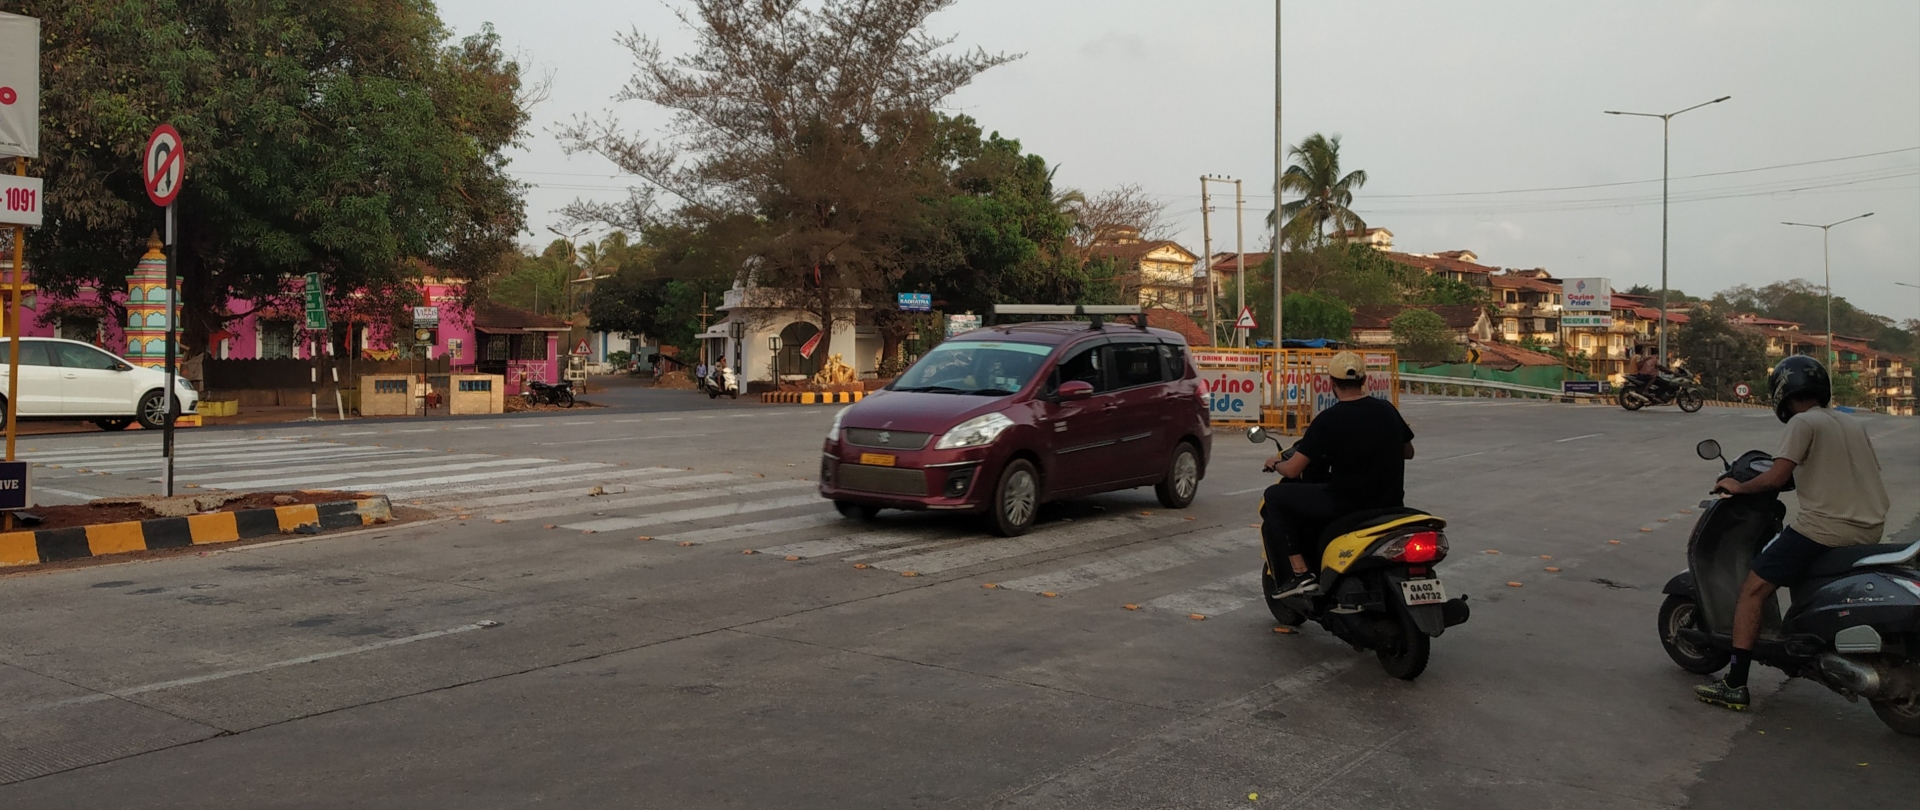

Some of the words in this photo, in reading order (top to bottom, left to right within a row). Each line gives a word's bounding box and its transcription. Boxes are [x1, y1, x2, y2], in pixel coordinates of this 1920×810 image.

[5, 187, 35, 212] 1091
[1210, 393, 1244, 412] ide
[1410, 584, 1422, 592] GA
[1422, 583, 1433, 591] 03
[1410, 592, 1442, 601] AA4732
